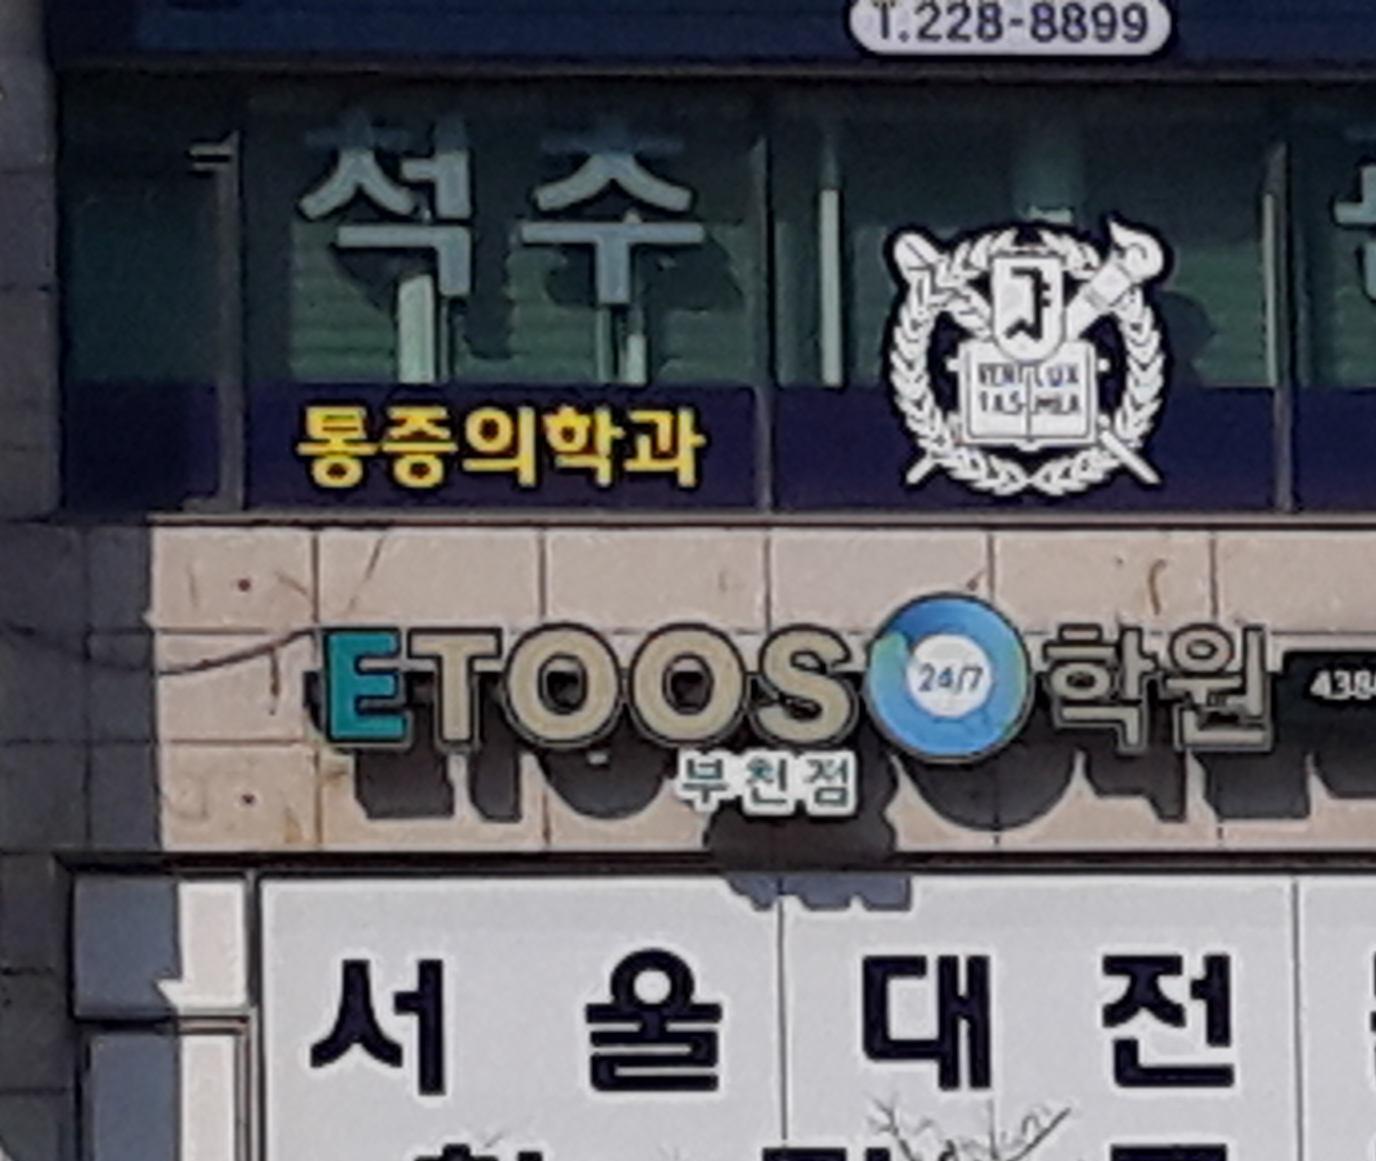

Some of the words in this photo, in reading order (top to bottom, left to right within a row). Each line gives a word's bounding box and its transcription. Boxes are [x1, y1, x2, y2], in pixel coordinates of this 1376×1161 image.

[870, 1, 1149, 43] T.228-8899
[298, 405, 707, 489] 통증의학과
[321, 622, 860, 750] ETOOS
[1044, 622, 1274, 753] 학원
[681, 755, 850, 807] 부천점
